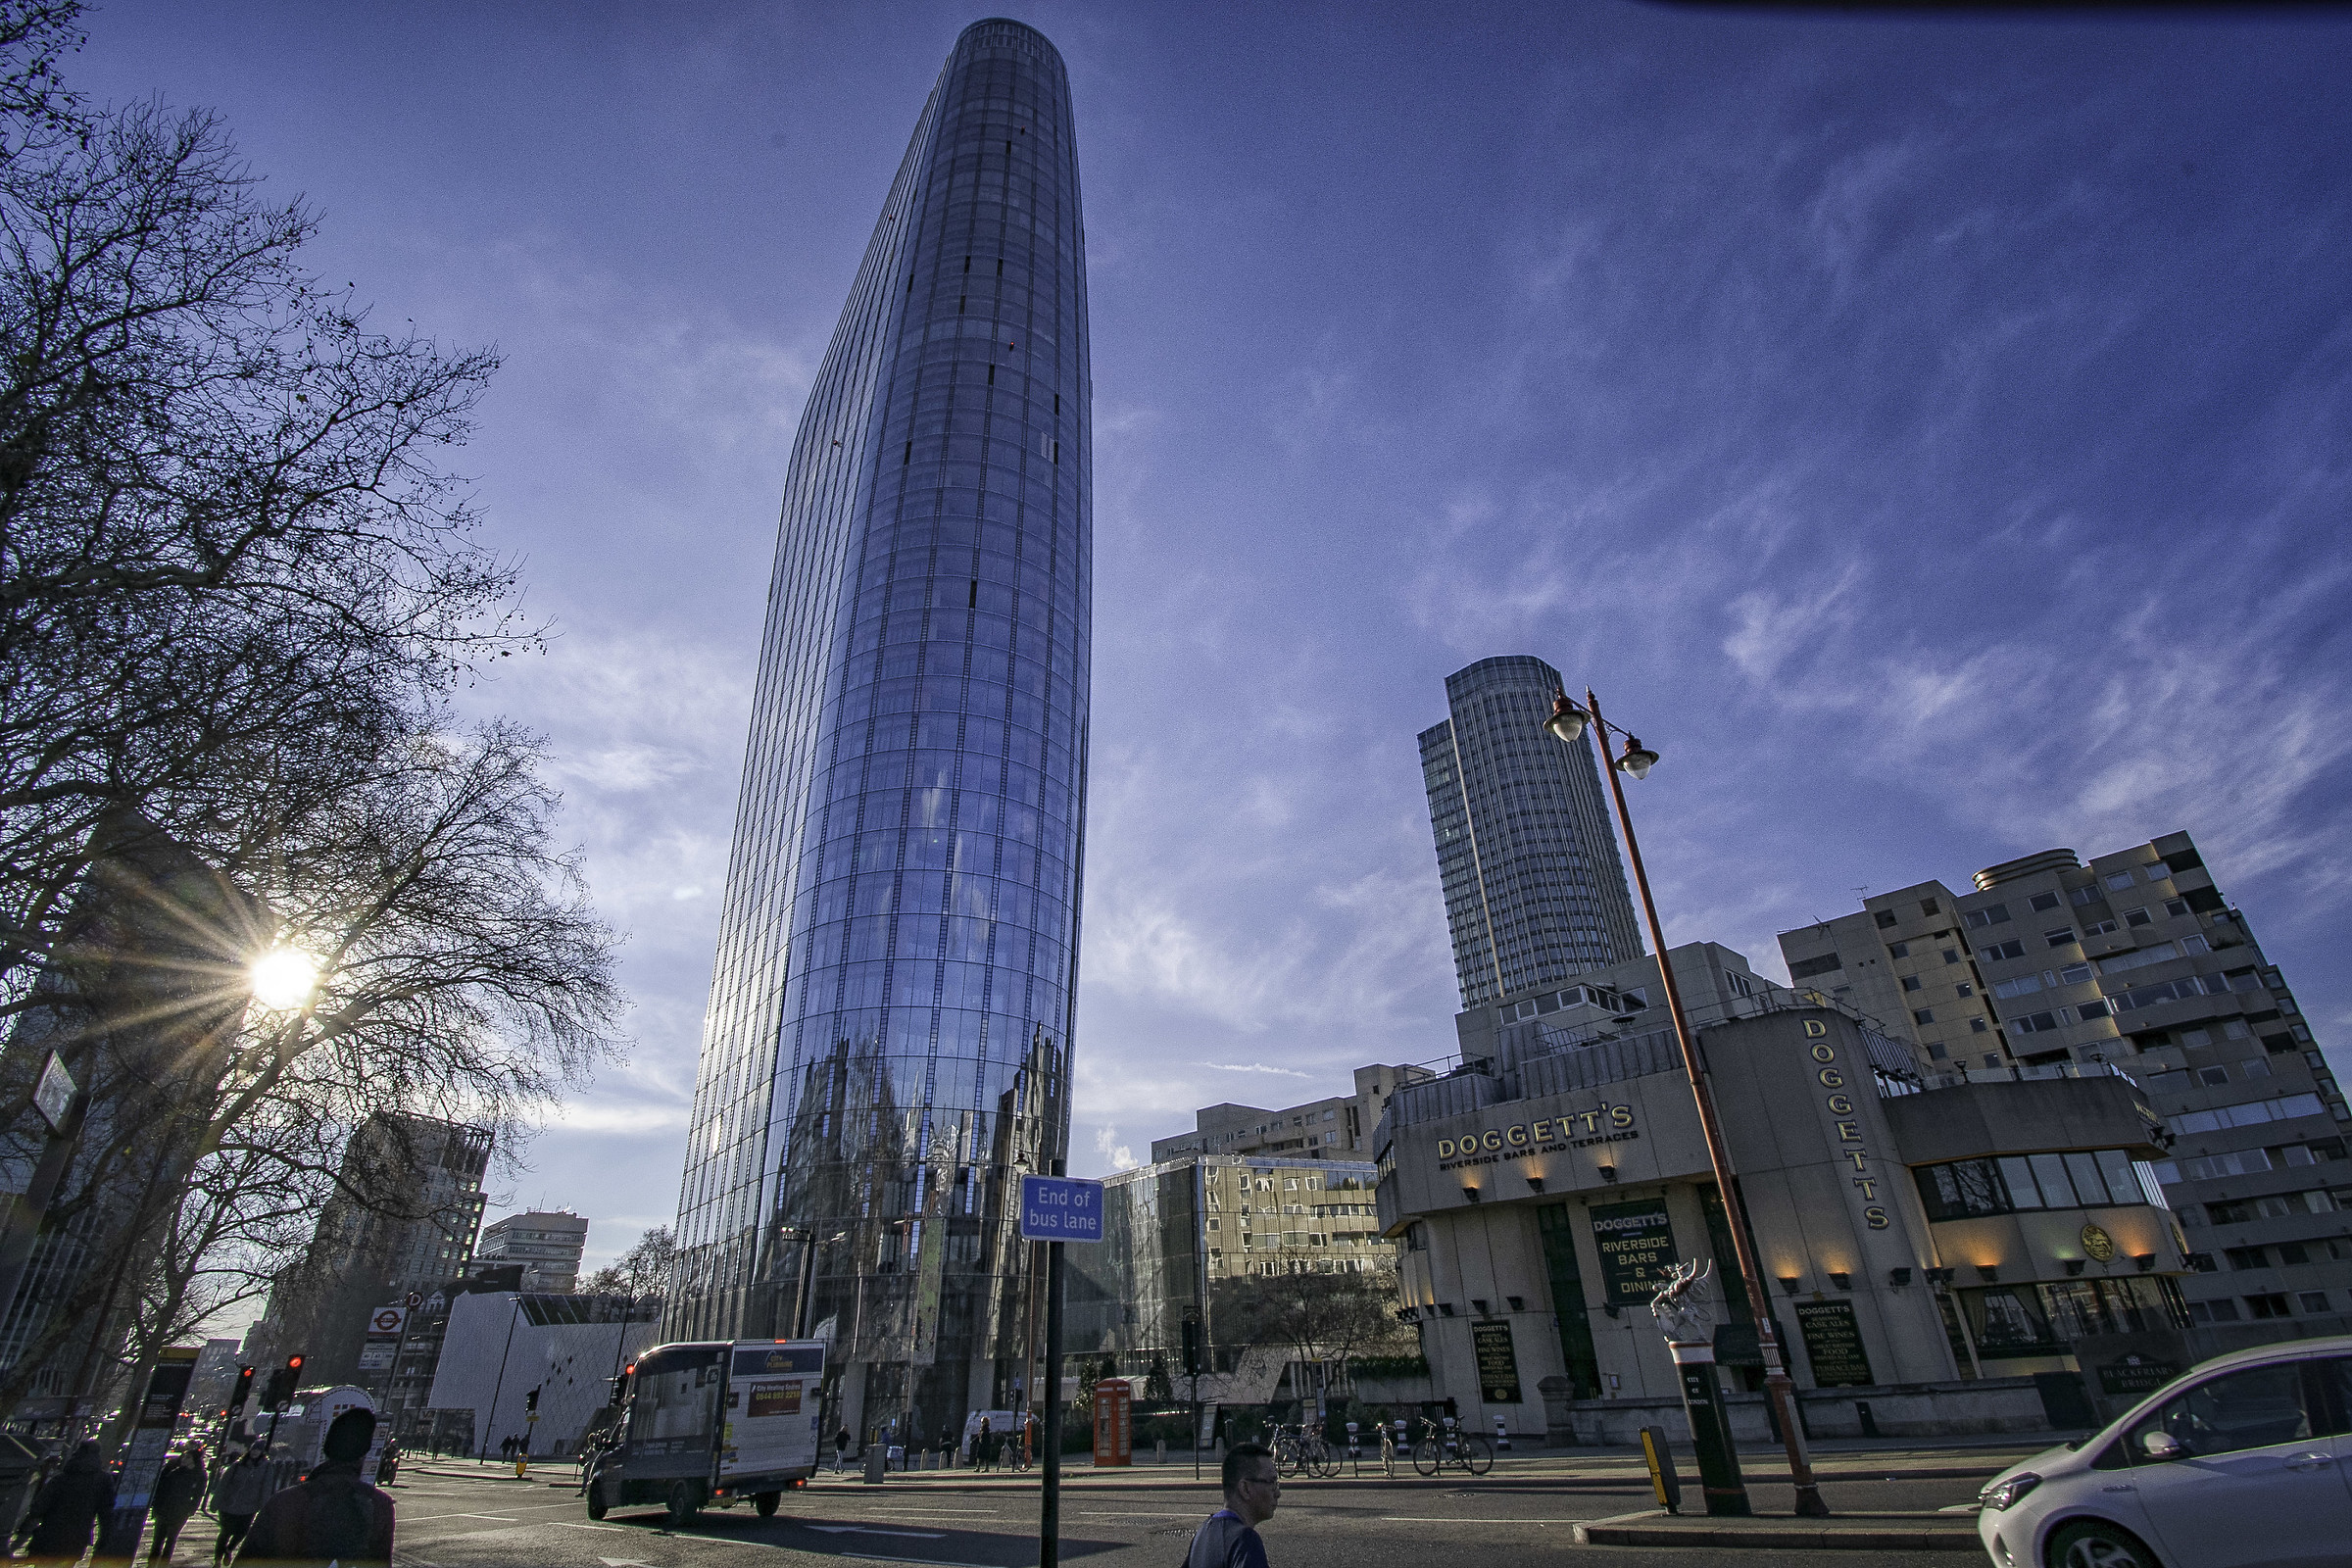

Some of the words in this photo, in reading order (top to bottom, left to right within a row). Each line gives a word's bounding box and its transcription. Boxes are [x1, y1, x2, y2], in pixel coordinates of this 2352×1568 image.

[1438, 1102, 1633, 1159] DOGGETT'S
[1440, 1154, 1499, 1171] RIVERSIDE
[1504, 1148, 1536, 1160] BARS
[1541, 1142, 1567, 1154] AND
[1571, 1130, 1639, 1148] TERRACES
[1039, 1187, 1068, 1205] End
[1074, 1191, 1091, 1207] of
[1030, 1208, 1057, 1228] bus
[1063, 1210, 1097, 1230] lane
[1593, 1211, 1668, 1232] DOGGETT'S
[1602, 1236, 1669, 1252] RIVERSIDE
[1618, 1251, 1657, 1265] BARS
[1636, 1267, 1645, 1278] &
[410, 1295, 421, 1306] D
[1799, 1305, 1850, 1315] DOGGETT'S
